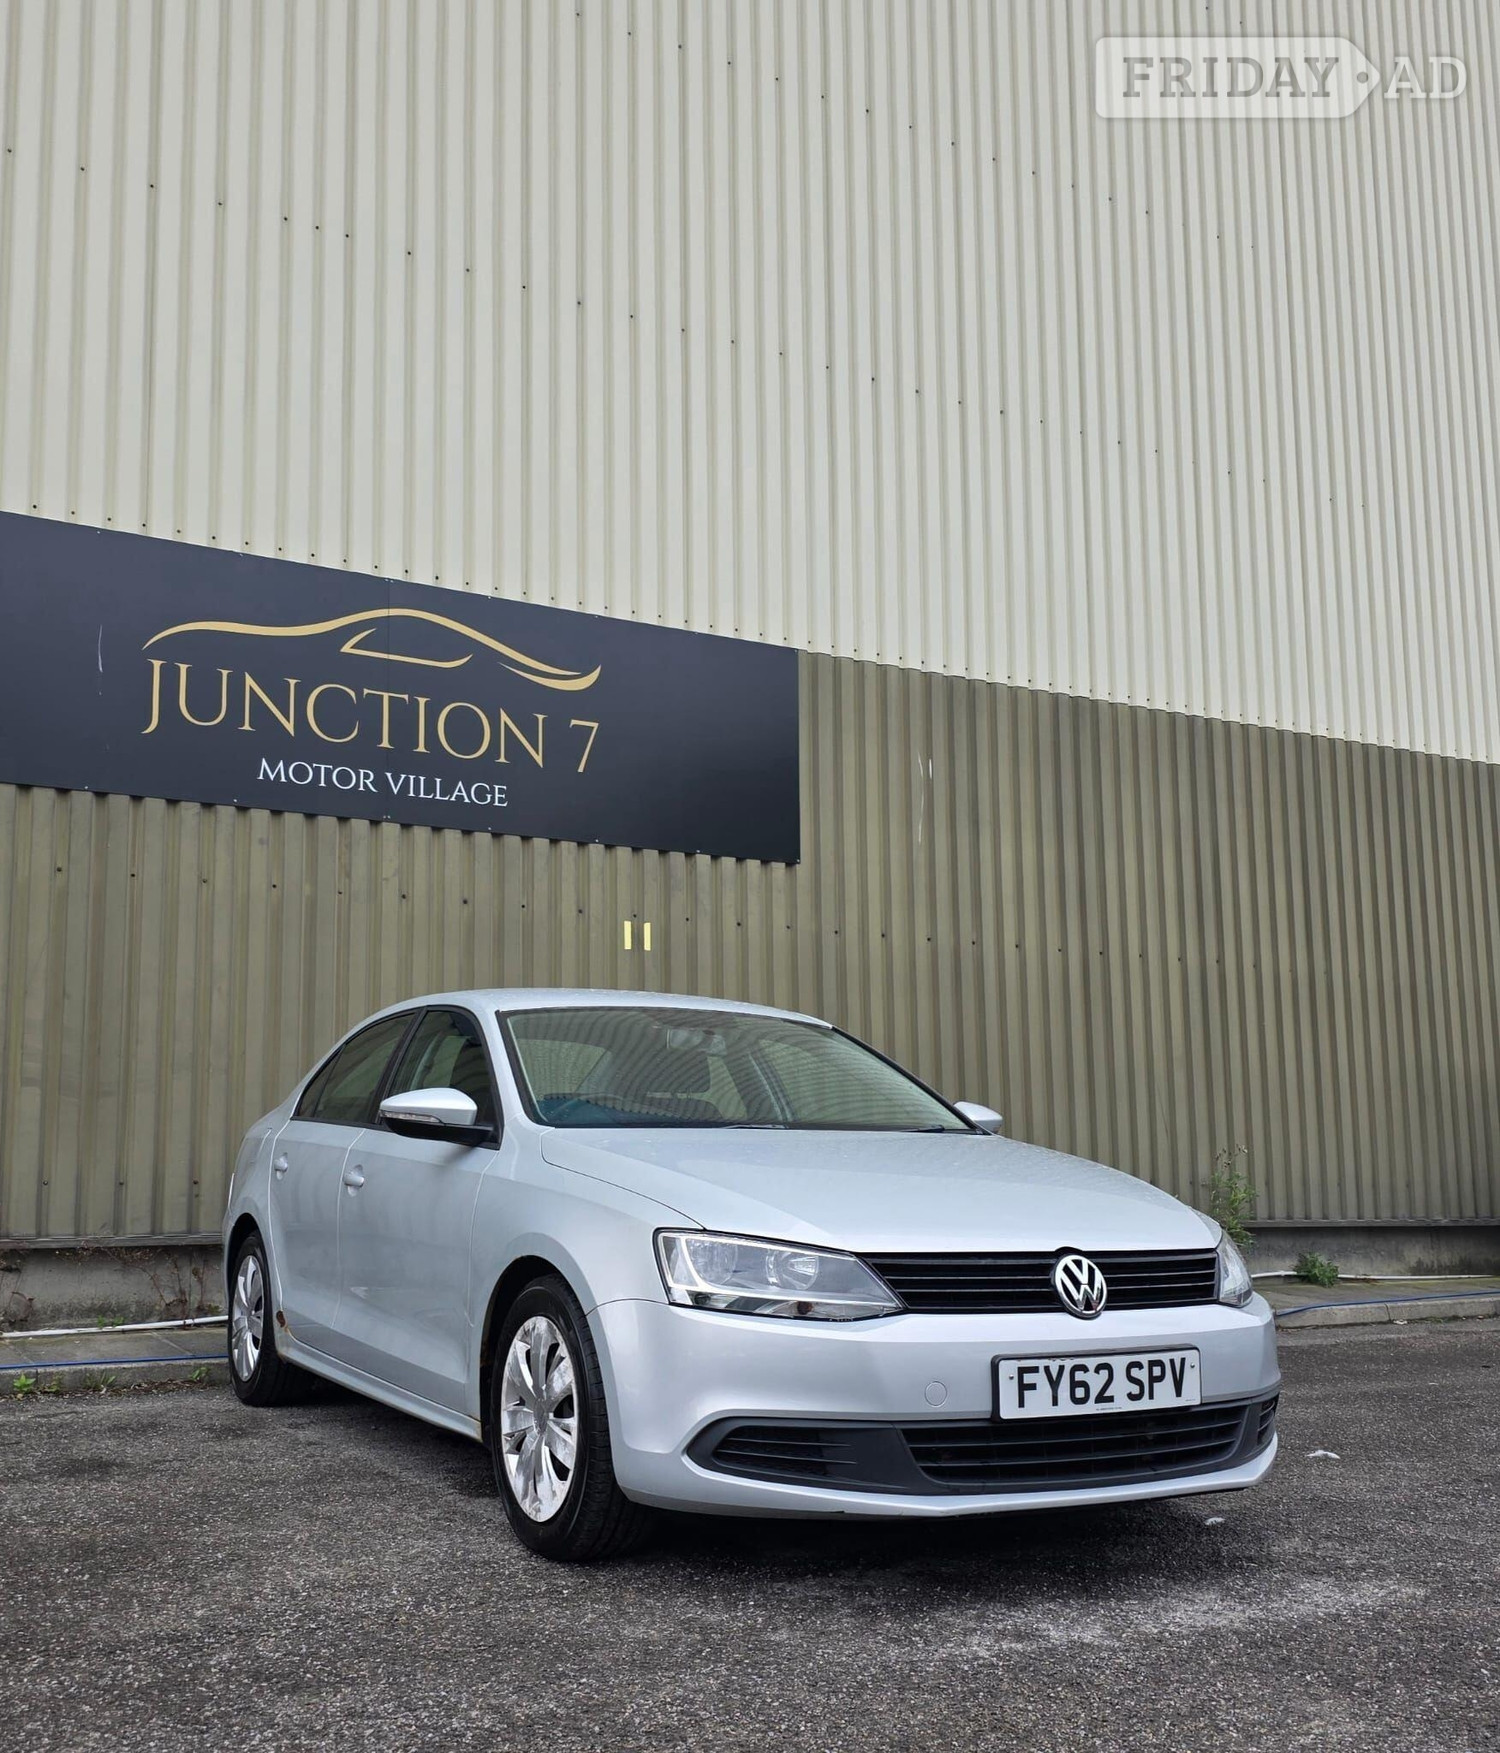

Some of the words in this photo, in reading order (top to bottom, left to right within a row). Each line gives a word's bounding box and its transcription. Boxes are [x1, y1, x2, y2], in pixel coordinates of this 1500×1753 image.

[141, 658, 549, 768] JUNCTION
[569, 718, 600, 773] 7
[257, 757, 379, 793] MOTOR
[385, 772, 509, 807] VILLAGE
[1017, 1362, 1115, 1409] FY62
[1125, 1357, 1187, 1402] SPV
